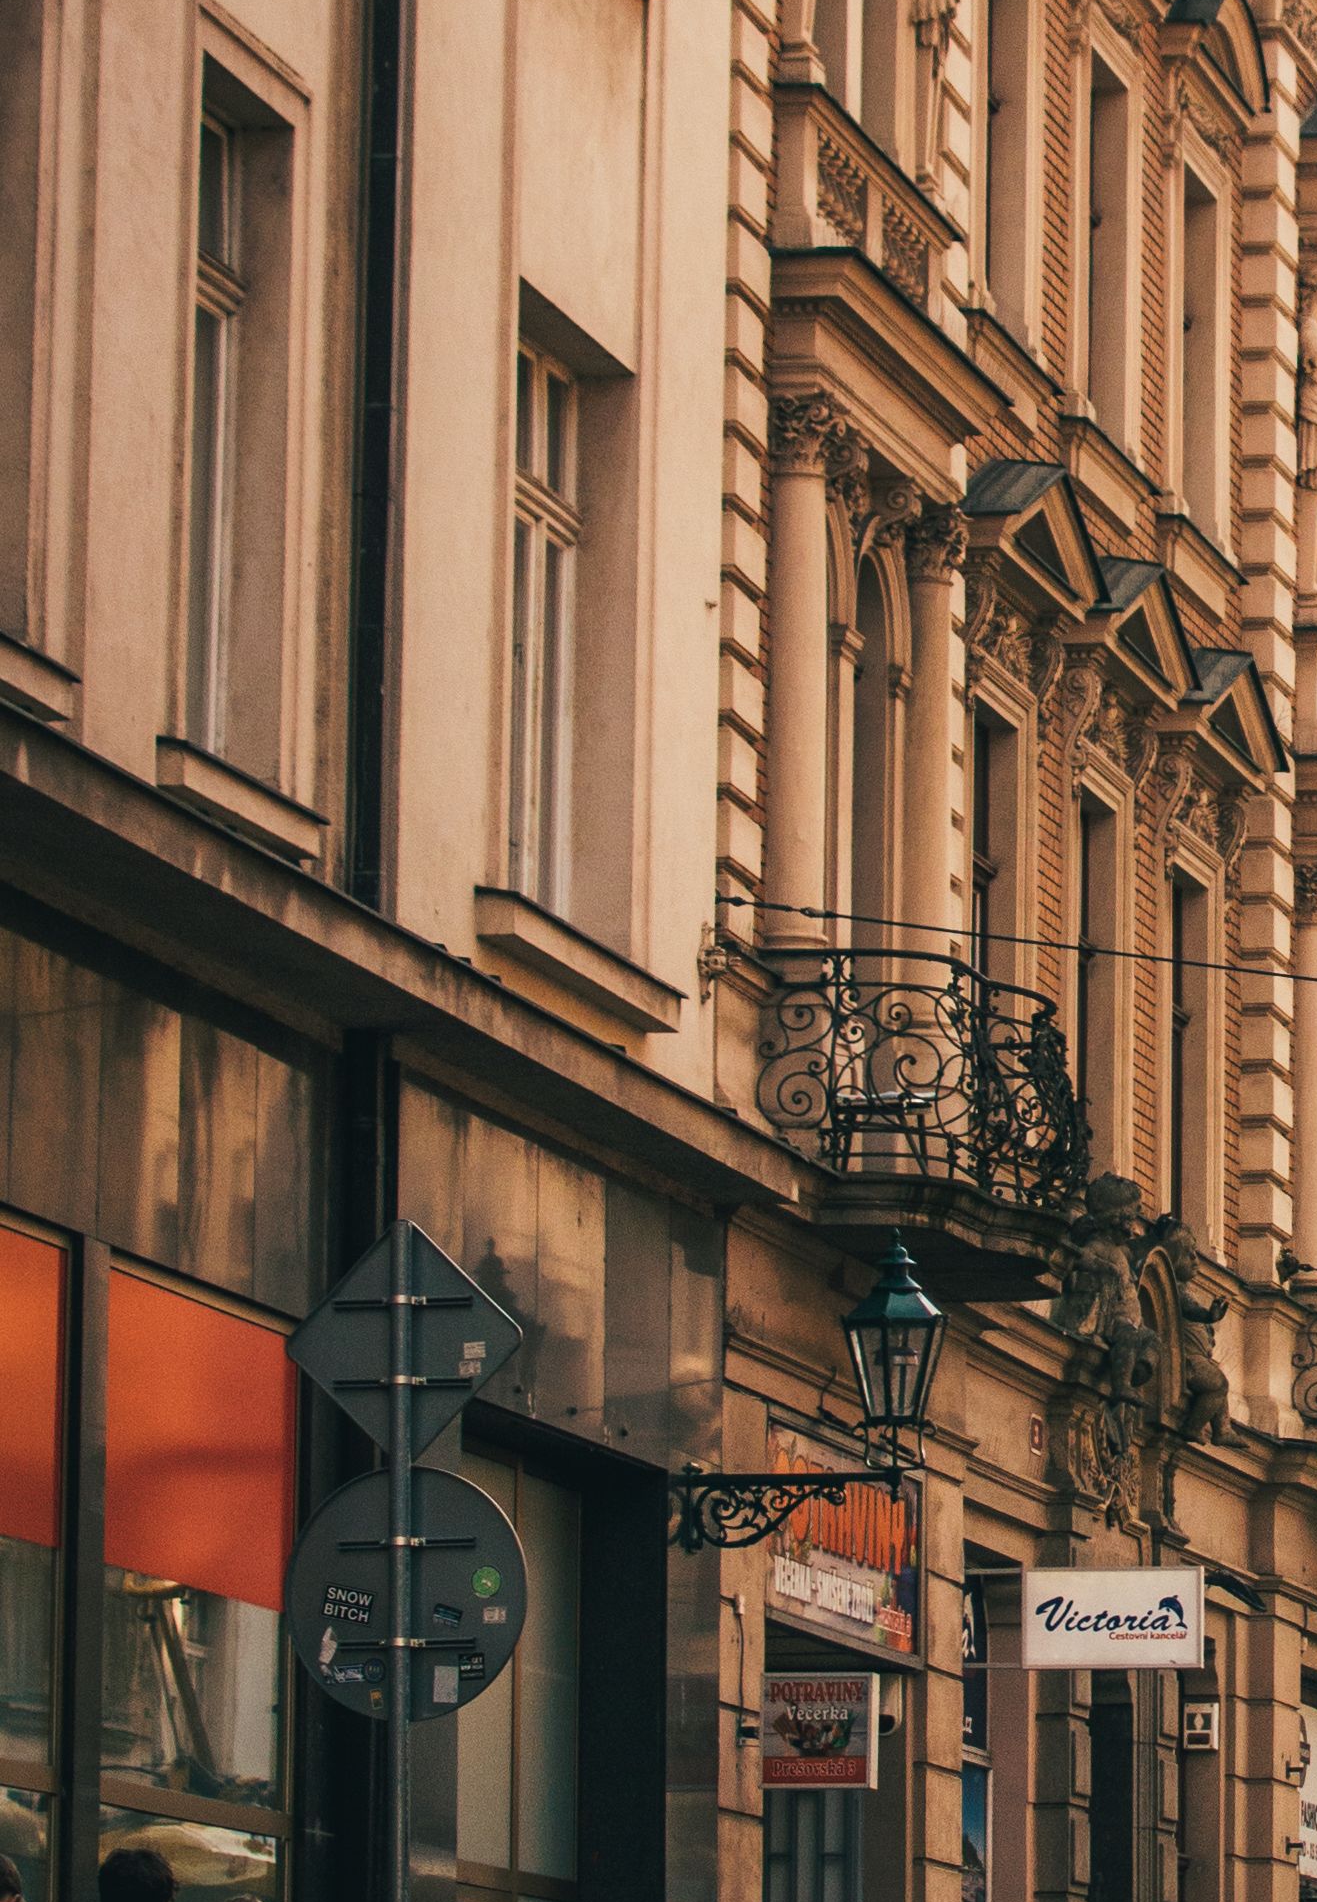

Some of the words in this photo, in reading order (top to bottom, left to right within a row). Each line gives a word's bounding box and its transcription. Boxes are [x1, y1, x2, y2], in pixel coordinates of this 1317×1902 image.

[327, 1586, 374, 1607] SNOW
[323, 1603, 370, 1623] BITCH
[1035, 1596, 1170, 1632] Victoria
[1109, 1632, 1148, 1640] Cestovní
[1150, 1631, 1187, 1640] kancelář
[769, 1681, 864, 1702] POTRAVINY
[786, 1705, 849, 1720] Večerka
[772, 1758, 845, 1777] Prešovská
[847, 1760, 856, 1776] 3
